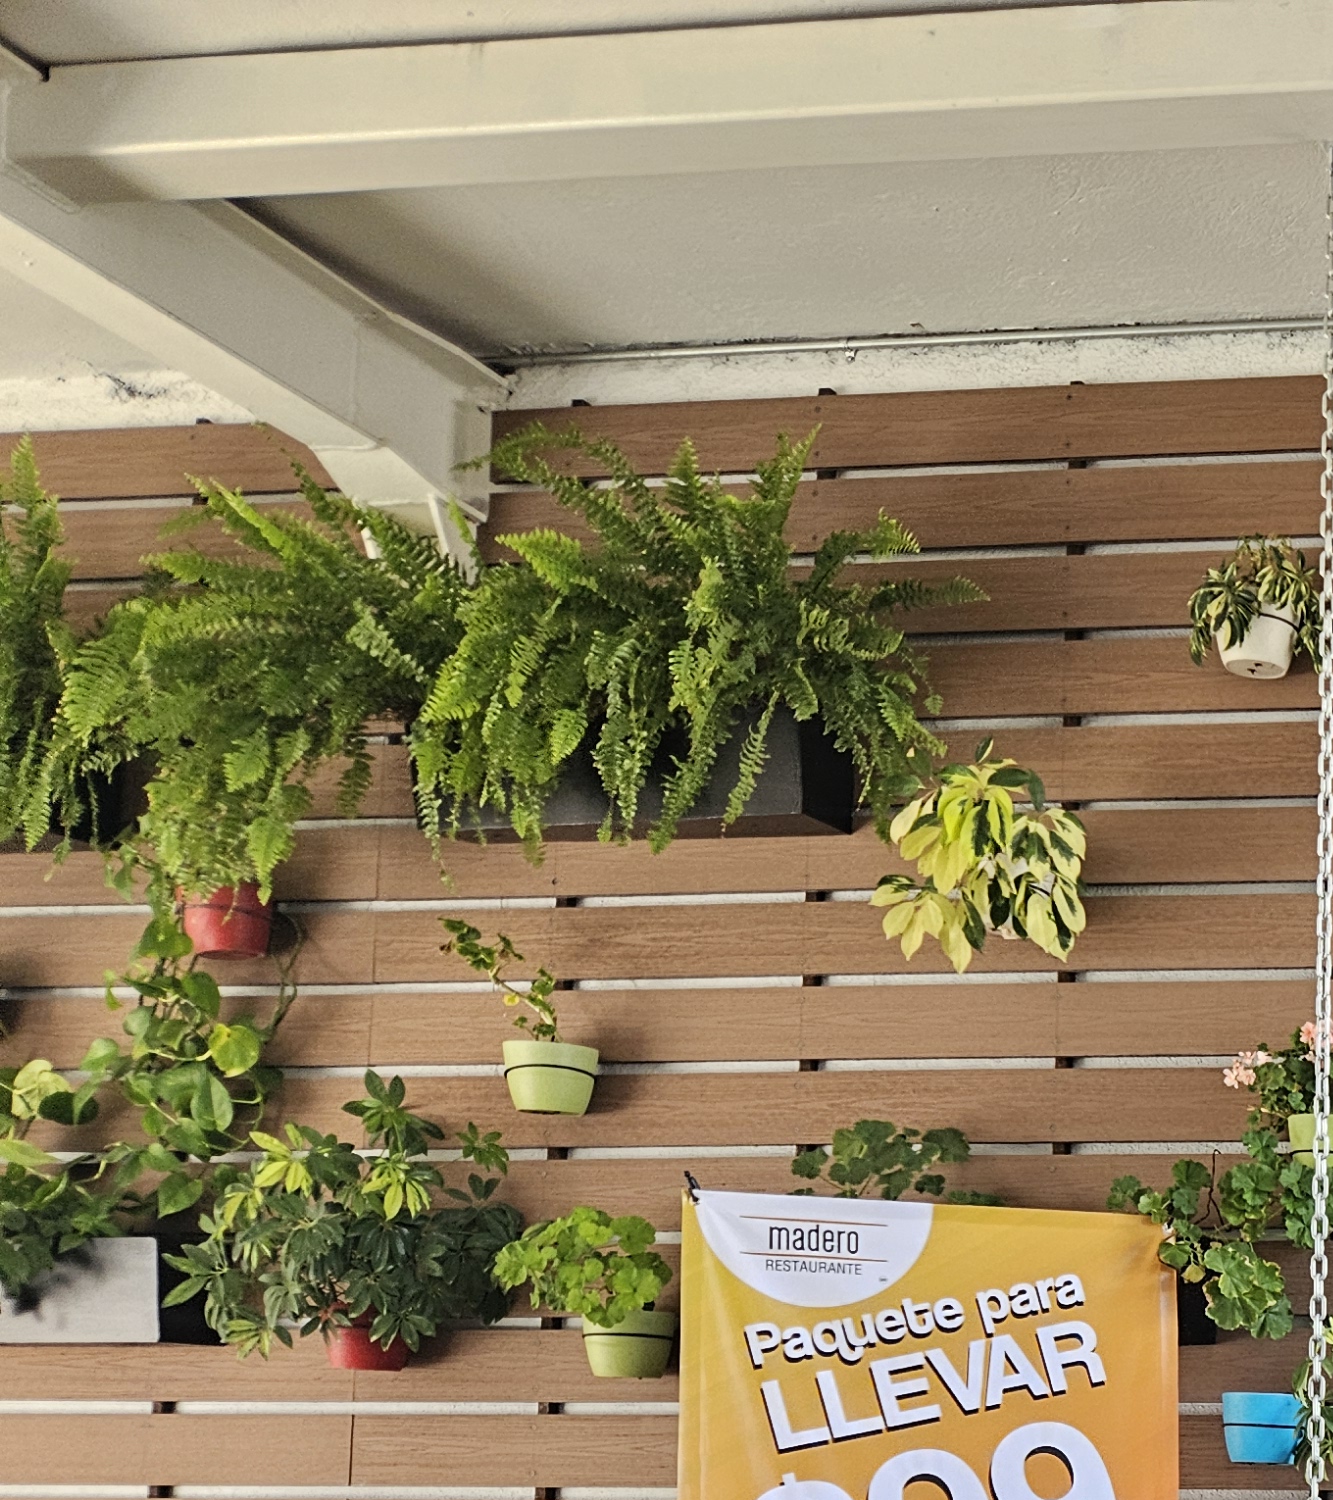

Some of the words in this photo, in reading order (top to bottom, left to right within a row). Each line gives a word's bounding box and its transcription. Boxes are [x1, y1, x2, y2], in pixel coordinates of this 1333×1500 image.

[766, 1259, 862, 1275] RESTAURANTE
[769, 1224, 859, 1254] madero
[744, 1296, 965, 1369] Paquete
[976, 1274, 1085, 1335] para
[760, 1320, 1107, 1453] LLEVAR
